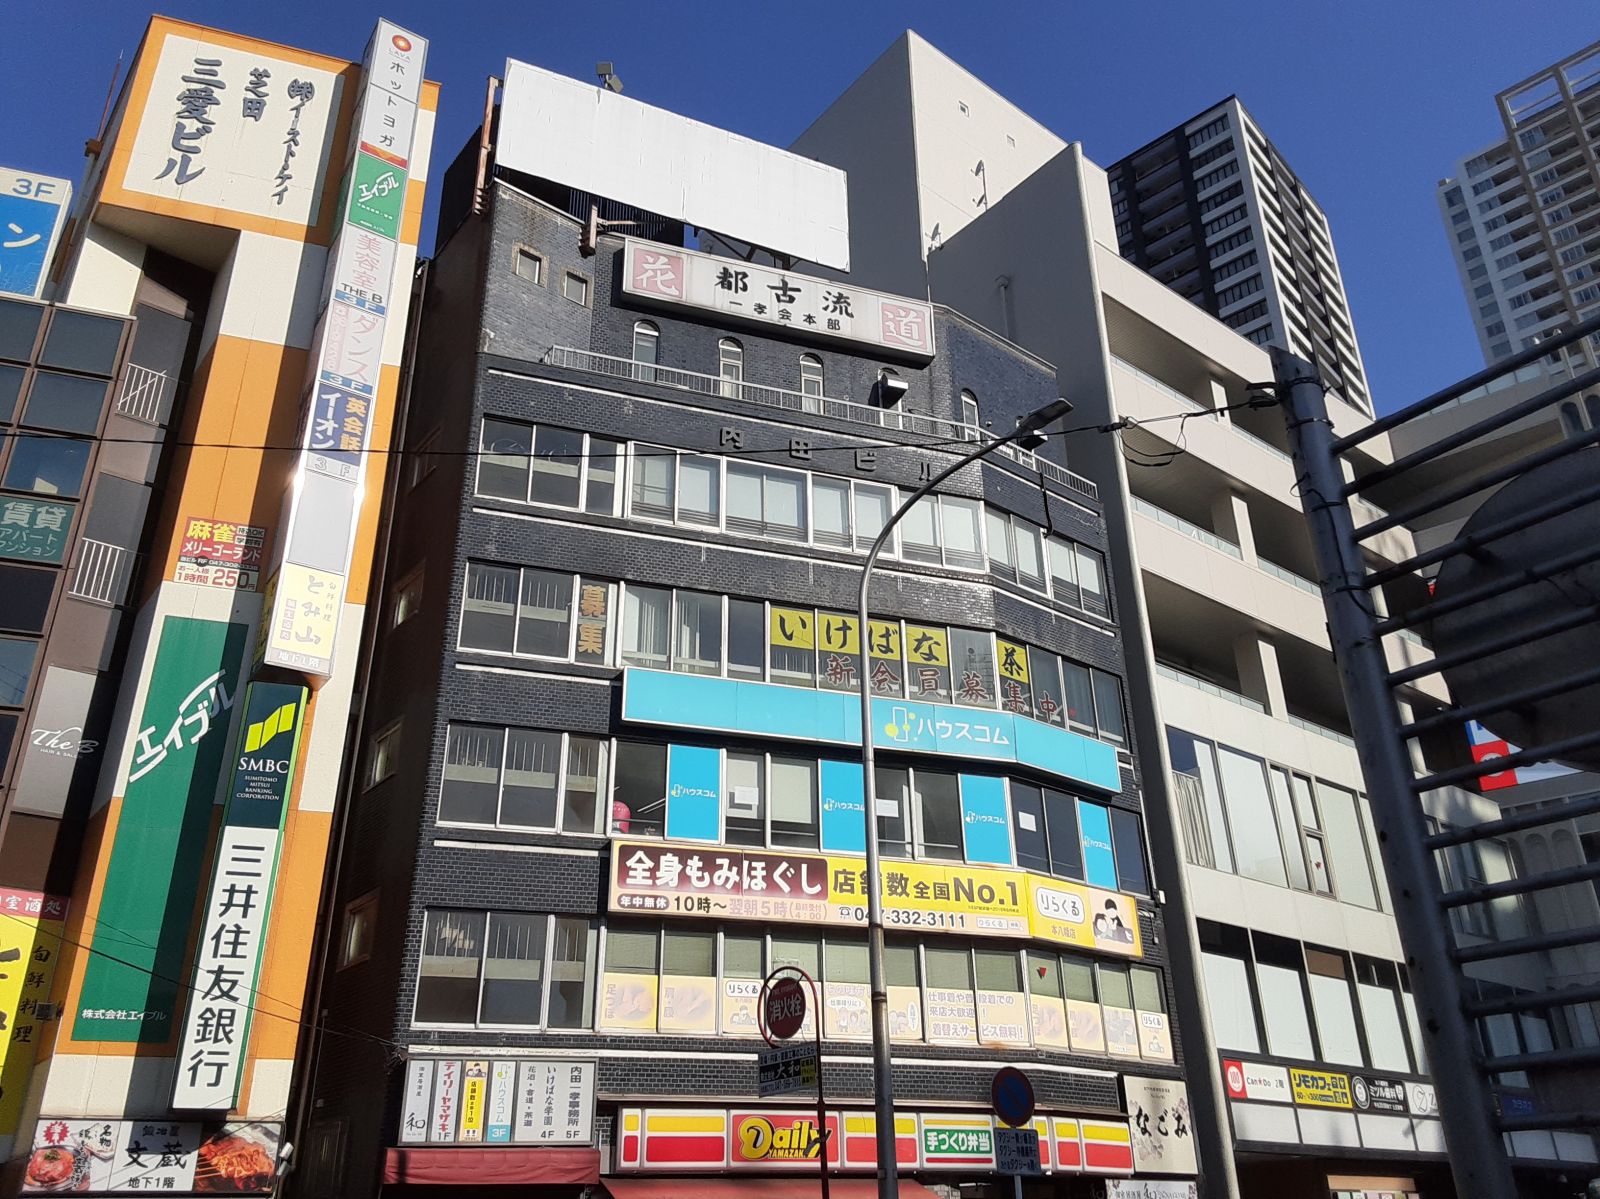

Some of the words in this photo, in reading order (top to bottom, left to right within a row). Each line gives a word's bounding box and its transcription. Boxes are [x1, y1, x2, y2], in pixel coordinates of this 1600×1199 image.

[243, 68, 271, 122] 芝田
[380, 62, 404, 146] ホットヨガ
[154, 57, 227, 185] 三愛ビル
[12, 178, 55, 197] 3F
[359, 172, 399, 202] エイブル
[351, 234, 381, 290] 美容室
[343, 293, 377, 311] 3F
[635, 254, 680, 296] 花
[714, 266, 854, 319] 都古流
[883, 309, 923, 347] 道
[729, 302, 841, 331] 一孝会本部
[344, 315, 378, 381] ダンス
[328, 374, 364, 390] 3F
[312, 392, 341, 449] イーオン
[340, 397, 368, 454] 英会話
[720, 426, 932, 481] 内田ビル
[315, 457, 350, 477] 3F
[1, 502, 66, 531] 賃貸
[187, 520, 236, 543] 麻雀
[183, 542, 261, 562] メリーゴーランド
[178, 572, 208, 584] 1時間
[212, 568, 255, 589] 250円
[577, 584, 606, 655] 募集
[778, 614, 943, 662] いけばな
[279, 651, 320, 668] 地下1階
[1001, 646, 1024, 678] 茶
[825, 654, 1058, 723] 新会員募集中
[129, 669, 235, 784] エイブル
[917, 718, 1010, 745] ハウスコム
[31, 727, 82, 749] The
[78, 740, 99, 753] B
[238, 757, 290, 774] SMBC
[245, 775, 278, 783] SUMITOMO
[236, 793, 280, 801] CORPORATION
[682, 787, 716, 798] ハウスコム
[975, 813, 1005, 824] ハウスコム
[625, 850, 822, 895] 全身もみほぐし
[0, 896, 61, 915] 室酒処
[620, 896, 667, 909] 年中無休
[1040, 893, 1080, 916] りらくる
[854, 907, 966, 929] 0-332-3111
[187, 844, 265, 1088] 三井住友銀行
[13, 946, 51, 1043] 旬鮮料理
[729, 984, 758, 994] りらくる
[82, 1008, 167, 1022] 株式会社エイブル
[770, 993, 802, 1022] 消火栓
[495, 1082, 507, 1123] ハウスコム
[544, 1065, 557, 1126] いけばな学園
[567, 1065, 582, 1127] 内田一孝事務所
[406, 1112, 425, 1131] 和
[492, 1128, 506, 1138] 3F
[1136, 1105, 1188, 1139] なごみ
[99, 1124, 112, 1147] 名物
[438, 1132, 451, 1141] 1F
[540, 1131, 555, 1139] 4F
[566, 1131, 580, 1139] 5F
[739, 1116, 832, 1159] Daily
[927, 1131, 990, 1152] 手づくり弁当
[125, 1141, 189, 1169] 文蔵
[128, 1176, 175, 1189] 地下1階
